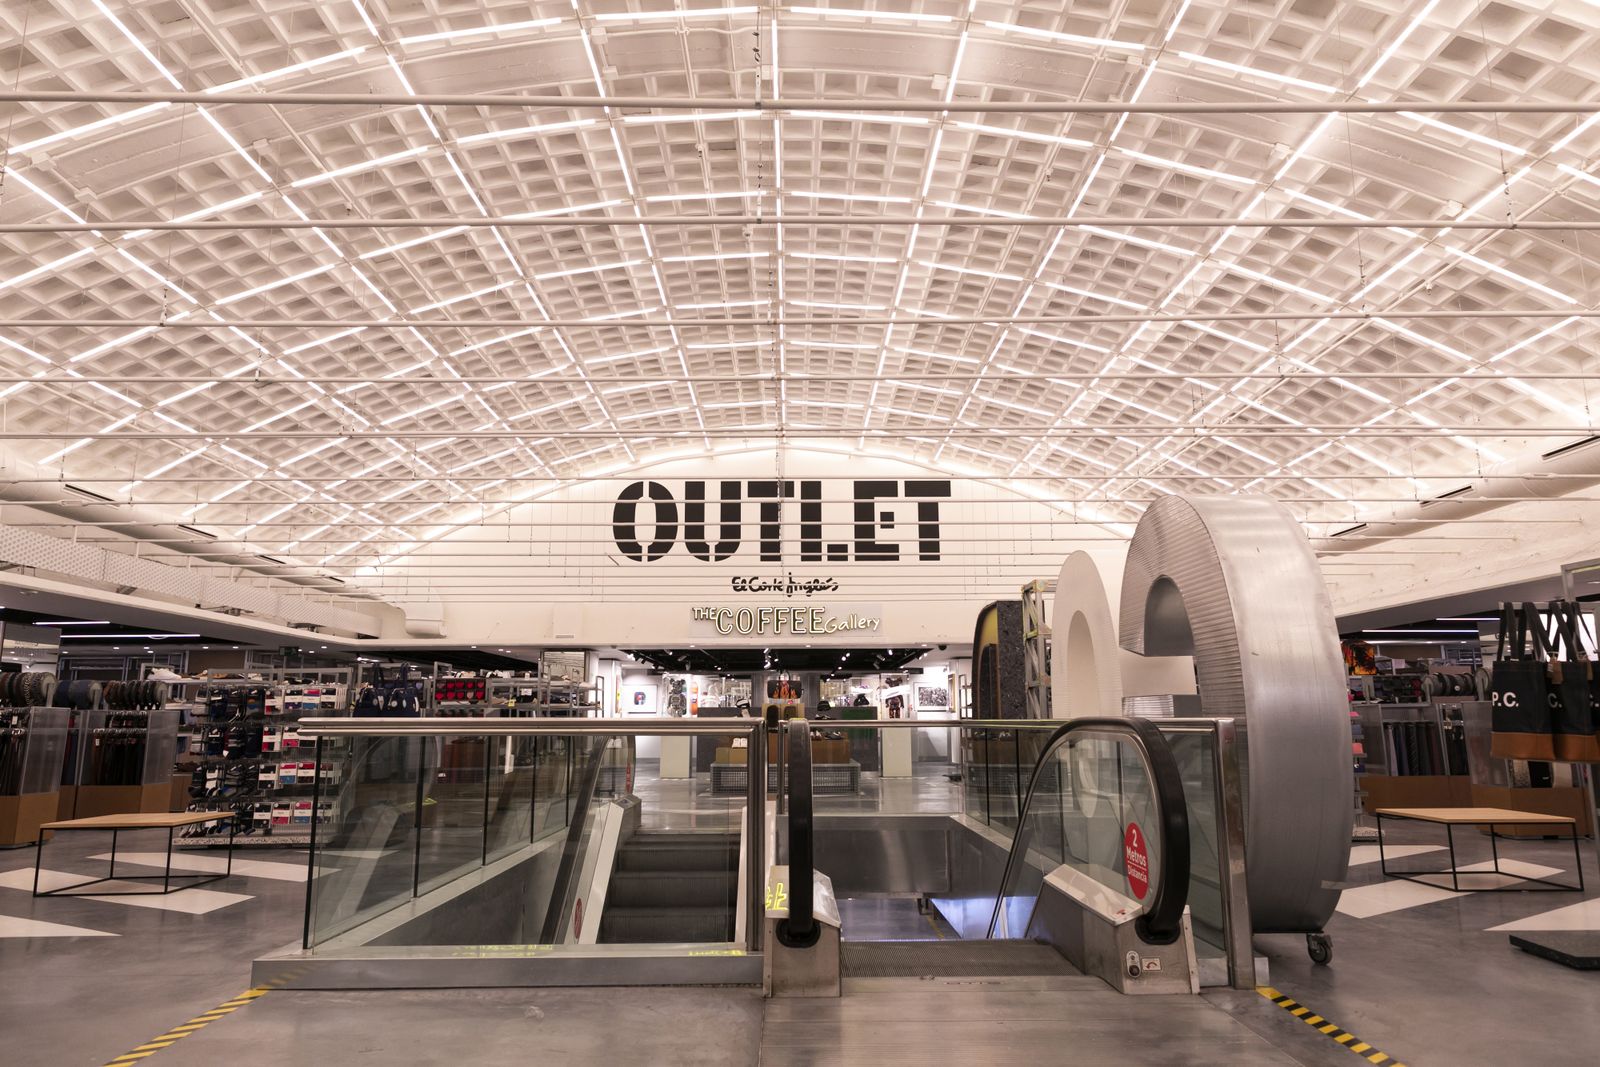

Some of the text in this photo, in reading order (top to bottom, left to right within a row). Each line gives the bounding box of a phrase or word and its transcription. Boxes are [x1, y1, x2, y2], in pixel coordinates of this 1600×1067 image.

[612, 481, 951, 562] OUTLET
[731, 576, 747, 592] El
[748, 576, 784, 592] Corte
[692, 607, 881, 634] THE COFFEE Gallery
[1132, 828, 1138, 848] 2
[1126, 846, 1147, 867] Metros
[1127, 864, 1148, 883] Distancia
